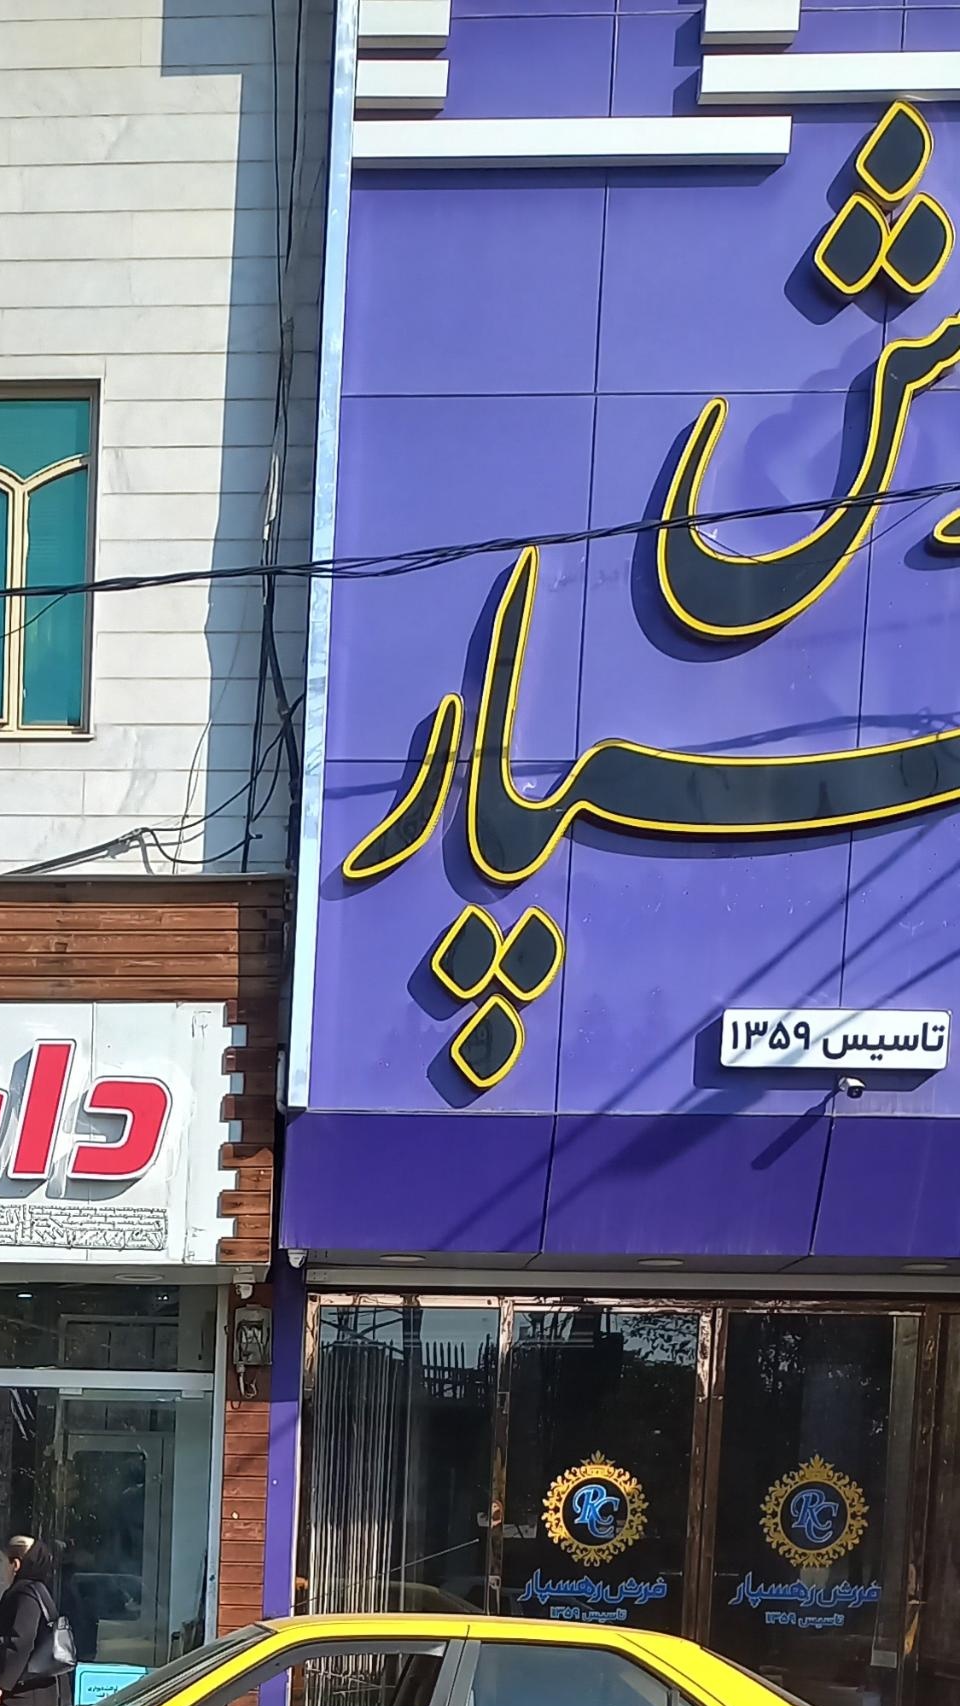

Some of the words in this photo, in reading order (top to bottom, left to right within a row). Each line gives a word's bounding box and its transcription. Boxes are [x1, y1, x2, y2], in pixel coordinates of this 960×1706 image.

[730, 1020, 811, 1050] ۱۳۵۹
[822, 1021, 946, 1061] تاسیس
[516, 1567, 604, 1605] رهسپار
[602, 1576, 668, 1605] فرش
[727, 1570, 817, 1609] رهسپار
[815, 1579, 882, 1608] فرش
[549, 1605, 581, 1620] ۱۳۵۹
[582, 1607, 628, 1623] تاسیس
[765, 1611, 797, 1625] ۱۳۵۹
[798, 1613, 845, 1629] تاسیس
